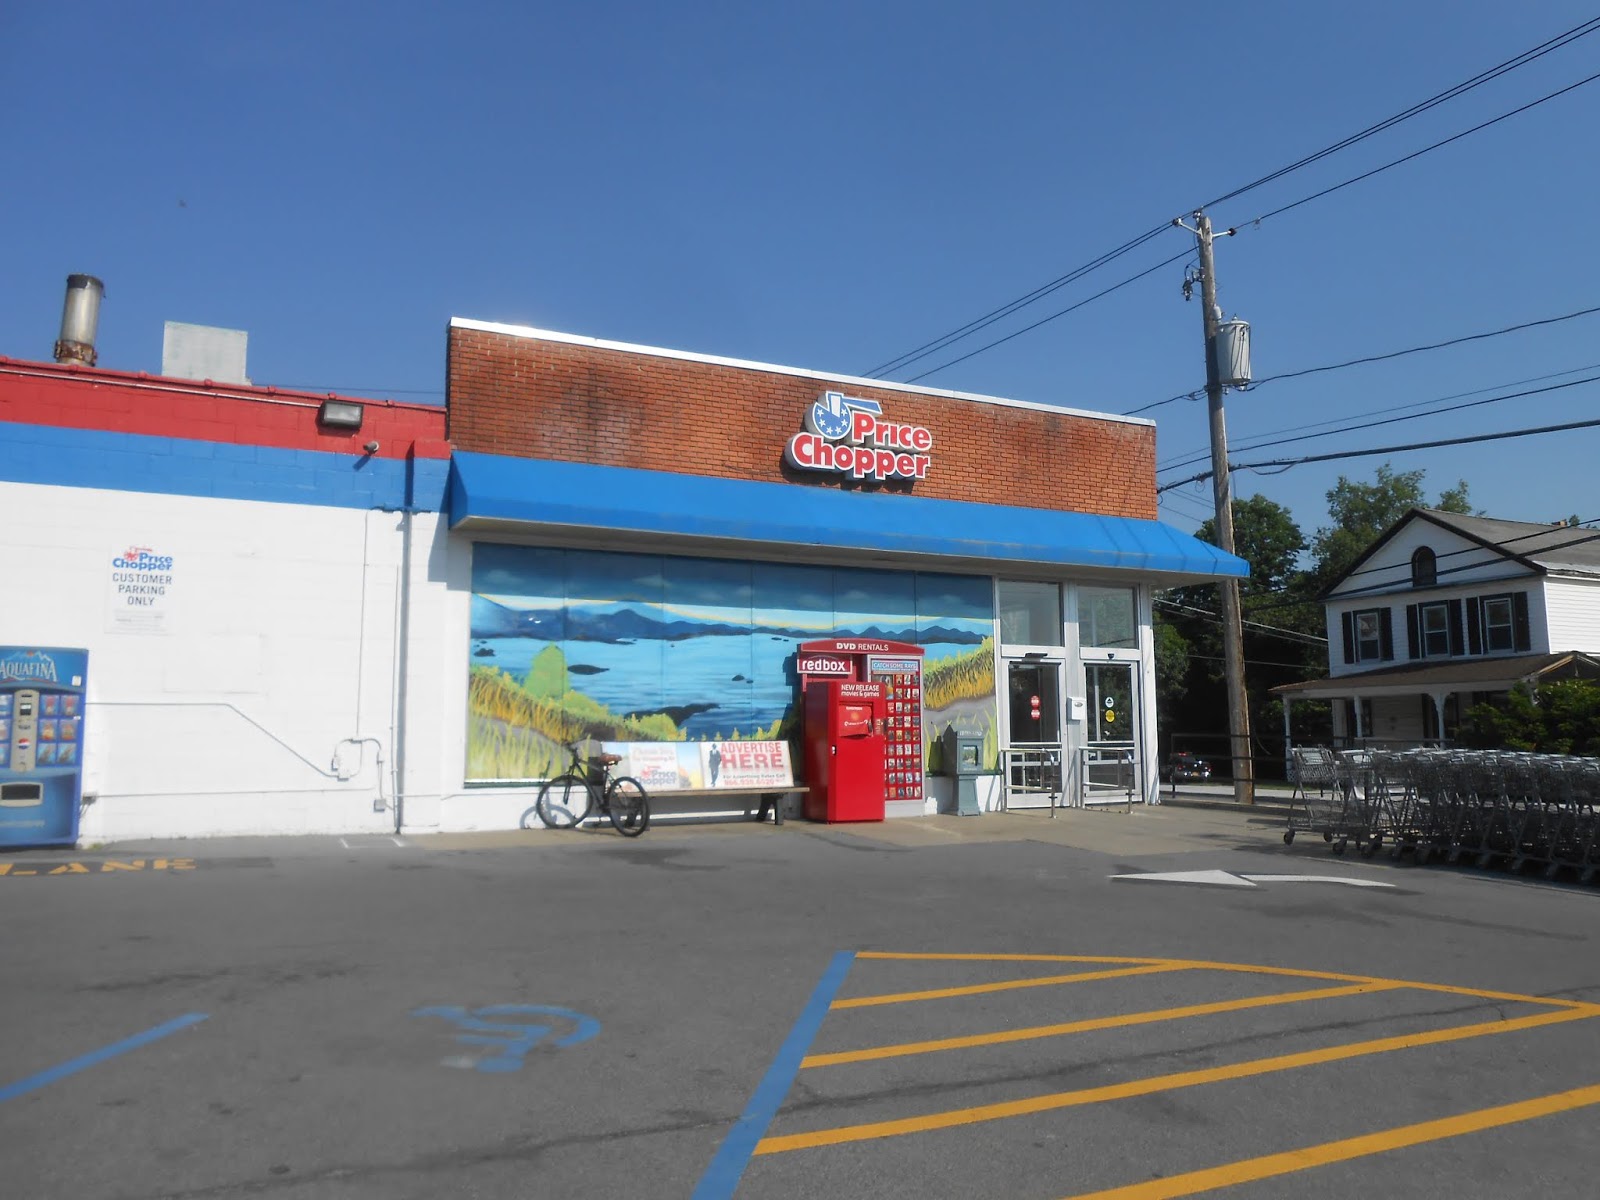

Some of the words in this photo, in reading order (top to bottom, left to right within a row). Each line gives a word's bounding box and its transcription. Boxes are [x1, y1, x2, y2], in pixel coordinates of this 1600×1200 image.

[852, 411, 932, 450] Price
[792, 432, 931, 480] Chopper
[139, 552, 173, 563] Price
[112, 557, 173, 571] Chopper
[112, 572, 172, 585] CUSTOMER
[118, 584, 165, 595] PARKING
[127, 595, 155, 606] ONLY
[836, 642, 856, 650] DVD
[857, 643, 889, 652] RENTALS
[0, 659, 57, 682] AQUAFINA
[802, 659, 846, 671] redbox
[855, 684, 880, 692] RELEASE
[721, 742, 782, 753] ADVERTISE
[721, 753, 784, 769] HERE
